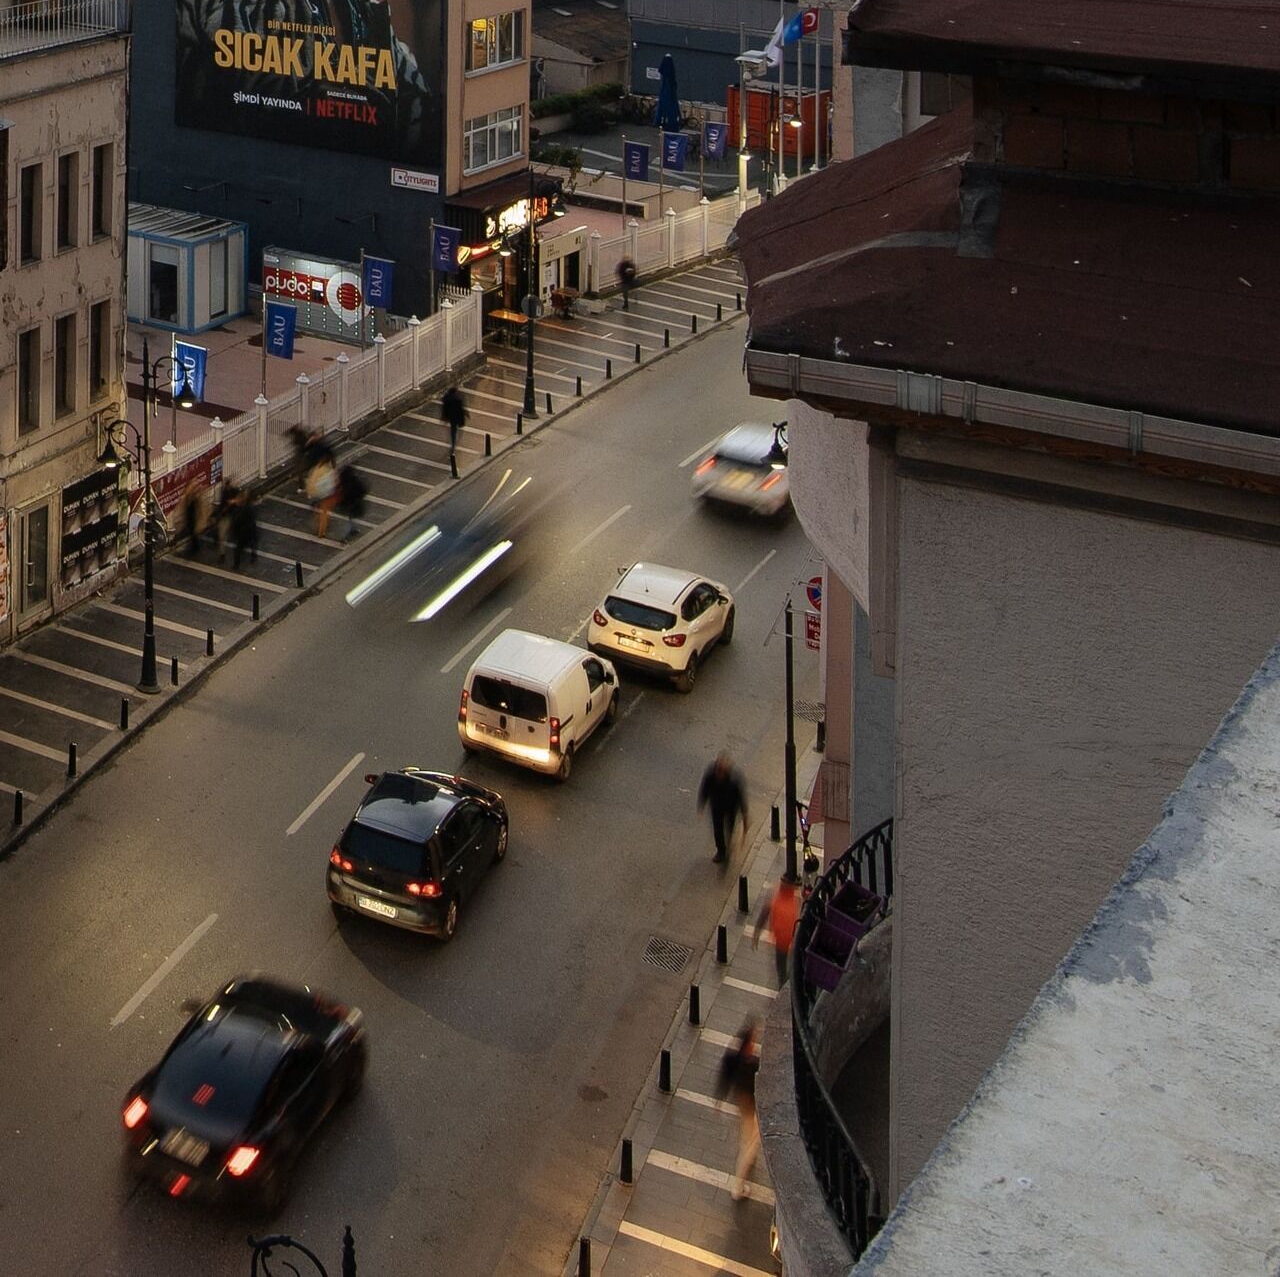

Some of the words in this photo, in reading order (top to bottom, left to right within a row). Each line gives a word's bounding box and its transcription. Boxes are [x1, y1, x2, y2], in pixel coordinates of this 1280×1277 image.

[282, 22, 312, 33] NETFLIX
[214, 28, 305, 78] SICAK
[313, 41, 397, 90] KAFA
[233, 90, 260, 105] ŞİMDİ
[261, 96, 303, 111] YAYINDA
[316, 98, 378, 125] NETFLIX
[667, 140, 680, 163] BAU
[707, 128, 720, 153] BAU
[630, 151, 641, 173] BAU
[440, 236, 451, 262] BAU
[265, 275, 308, 295] pudo
[370, 268, 384, 297] BAU
[273, 315, 286, 346] BAU
